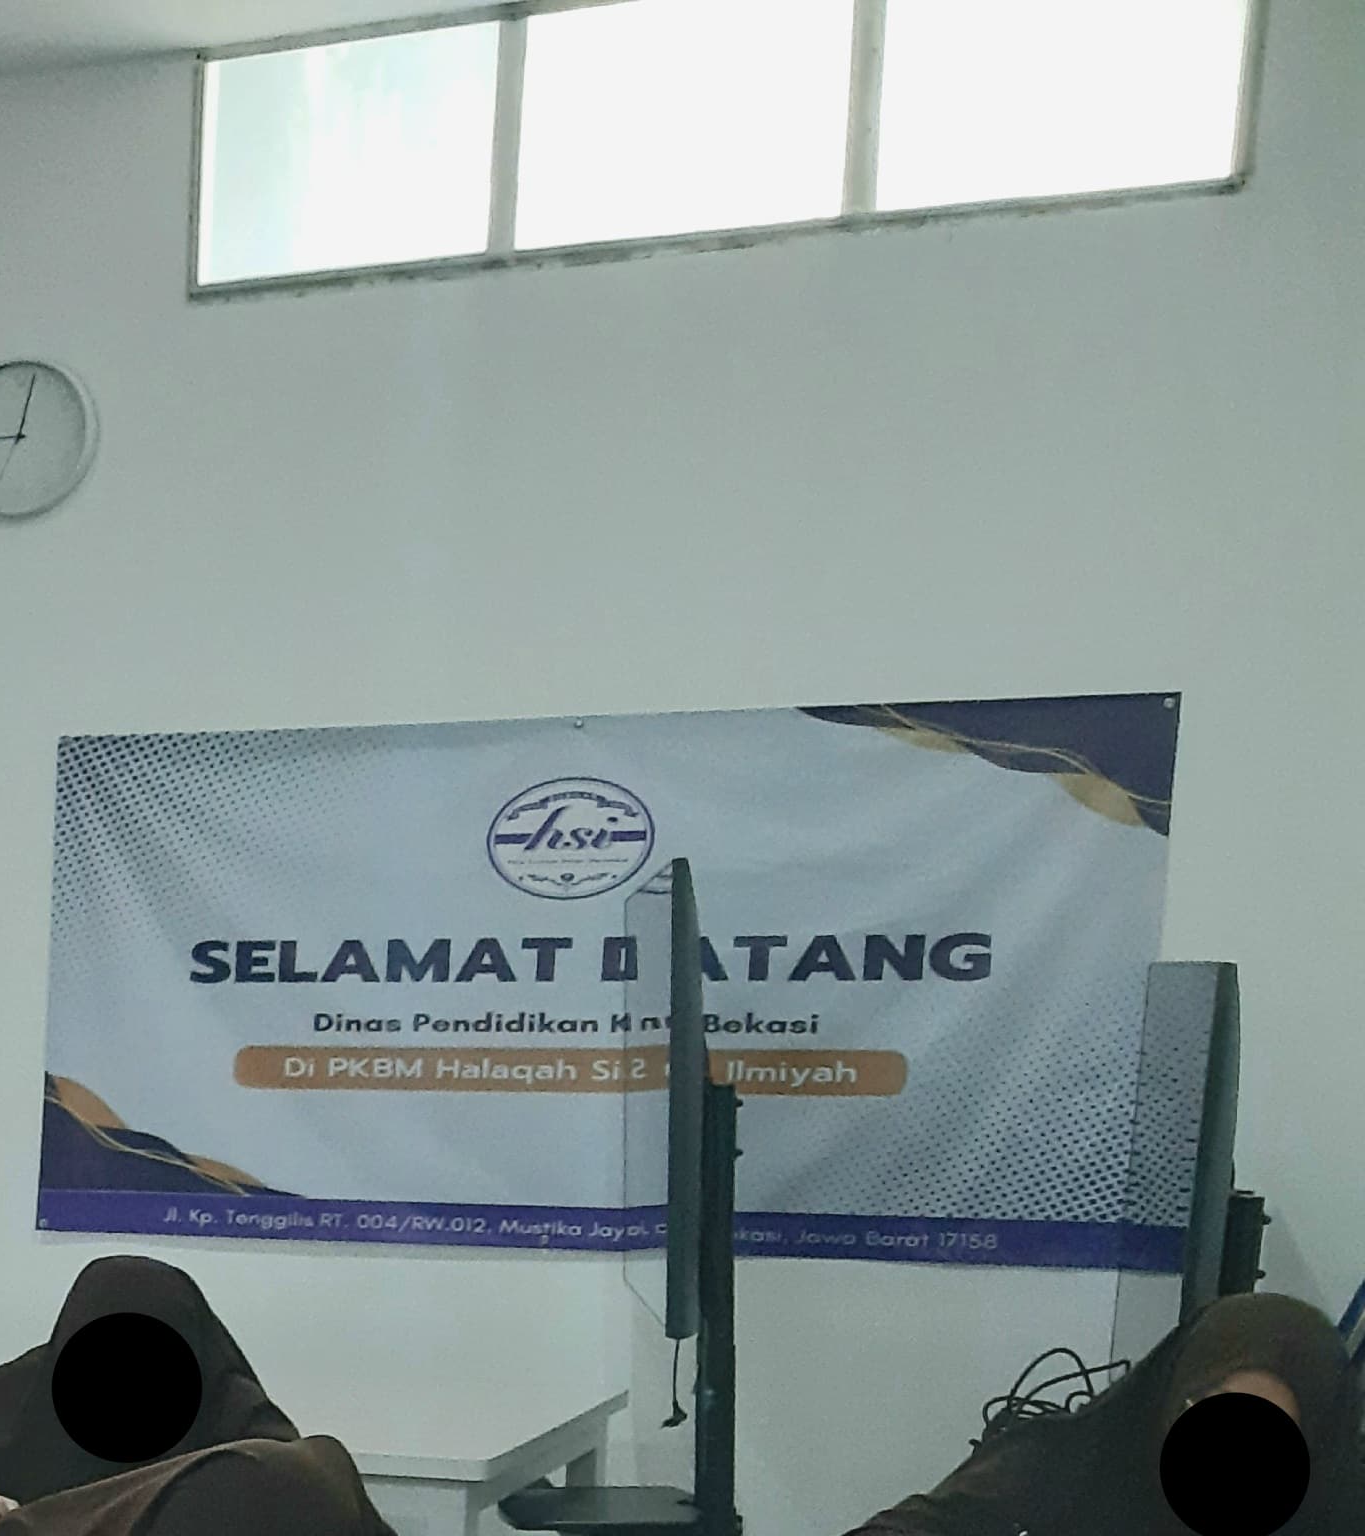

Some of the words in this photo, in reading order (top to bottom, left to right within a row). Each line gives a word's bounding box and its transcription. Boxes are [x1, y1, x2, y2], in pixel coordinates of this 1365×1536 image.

[189, 937, 573, 984] SELAMAT
[313, 1012, 402, 1034] Dinas
[413, 1012, 599, 1034] Pendidikan
[702, 1012, 819, 1035] Bekasi
[284, 1056, 315, 1078] Di
[328, 1057, 423, 1079] PKBM
[435, 1057, 578, 1085] Halaqah
[726, 1060, 858, 1086] Ilmiyah
[499, 1218, 582, 1237] Mustika
[865, 1230, 929, 1248] Barat
